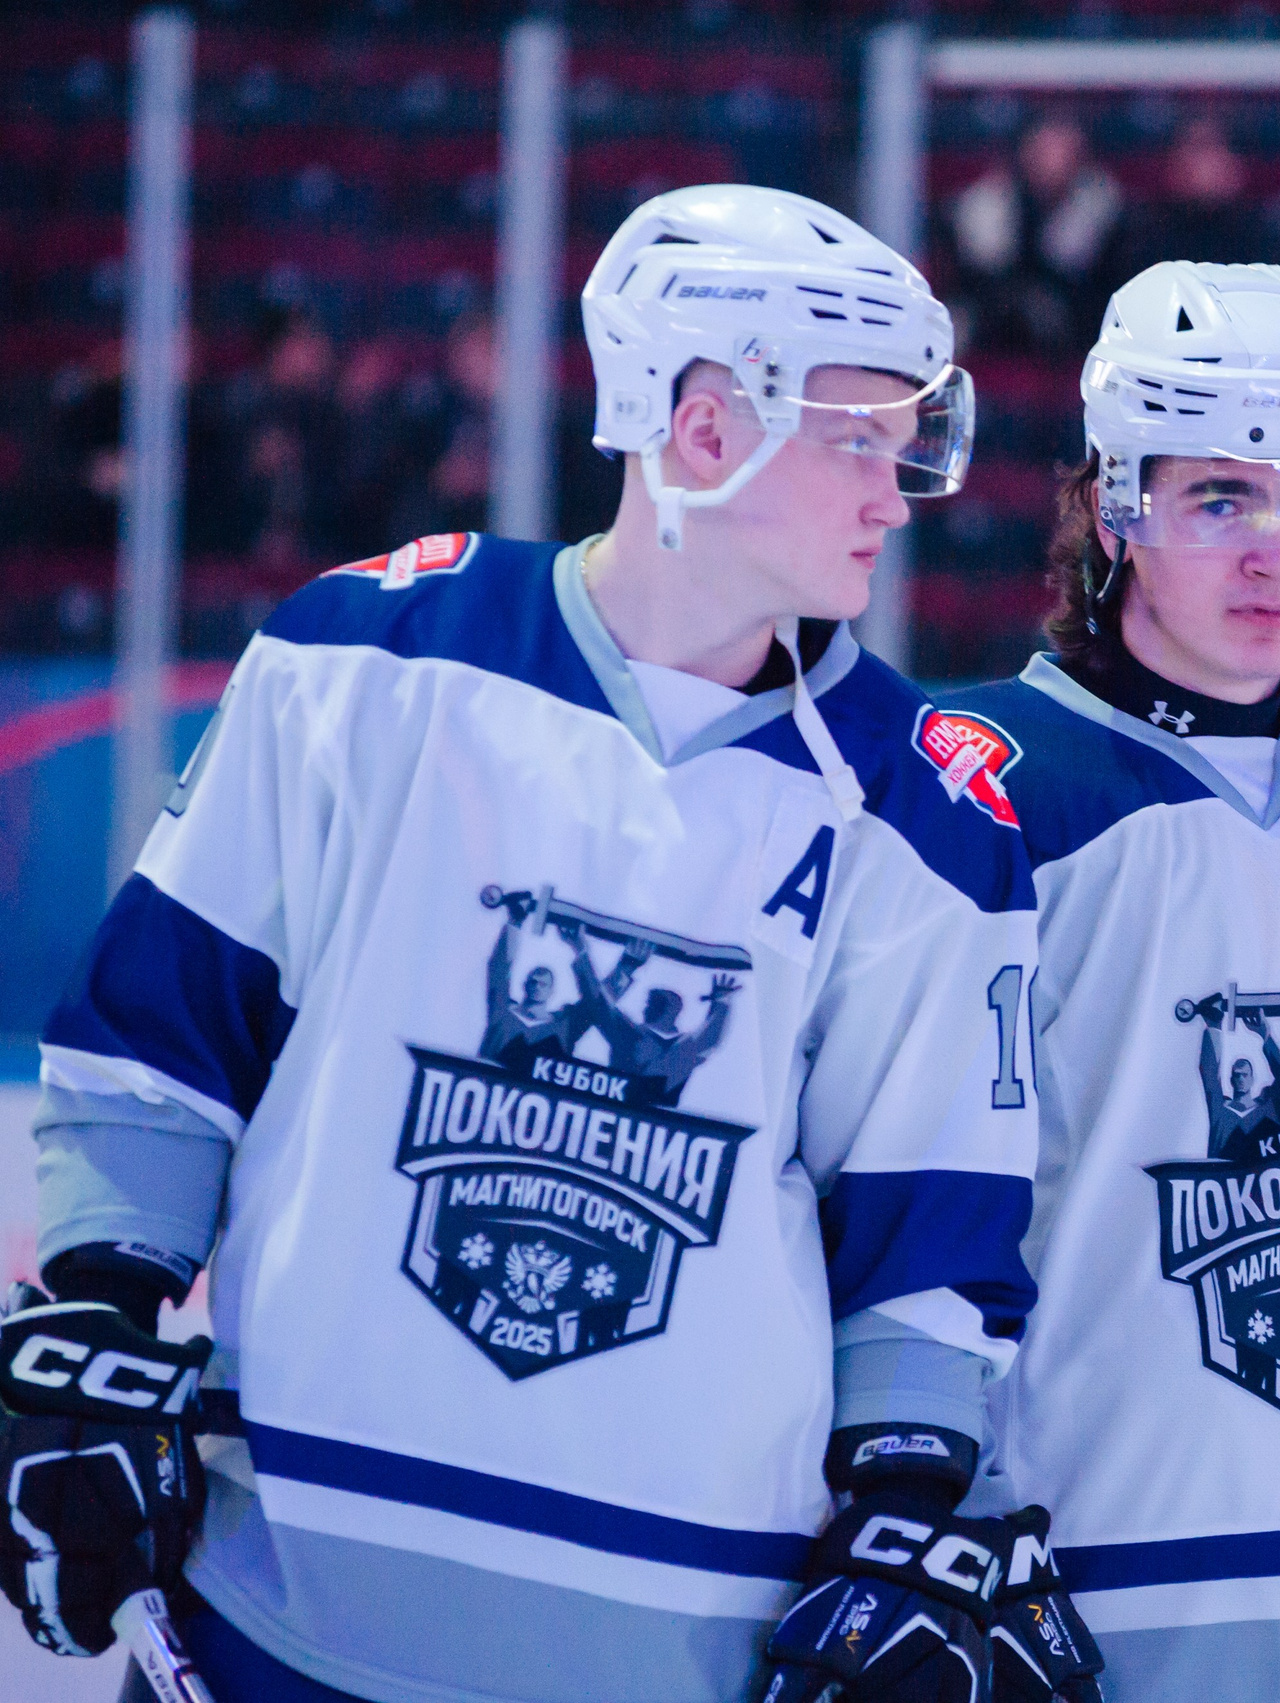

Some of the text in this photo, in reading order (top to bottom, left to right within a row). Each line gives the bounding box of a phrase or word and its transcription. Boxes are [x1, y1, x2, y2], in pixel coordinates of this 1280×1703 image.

[677, 285, 767, 302] BAUER
[761, 824, 835, 941] A
[987, 964, 1040, 1110] 1
[532, 1057, 629, 1101] КУБОК
[412, 1067, 728, 1220] ПОКОЛЕНИЯ
[449, 1174, 651, 1253] МАГНИТОГОРСК
[489, 1316, 553, 1356] 2025
